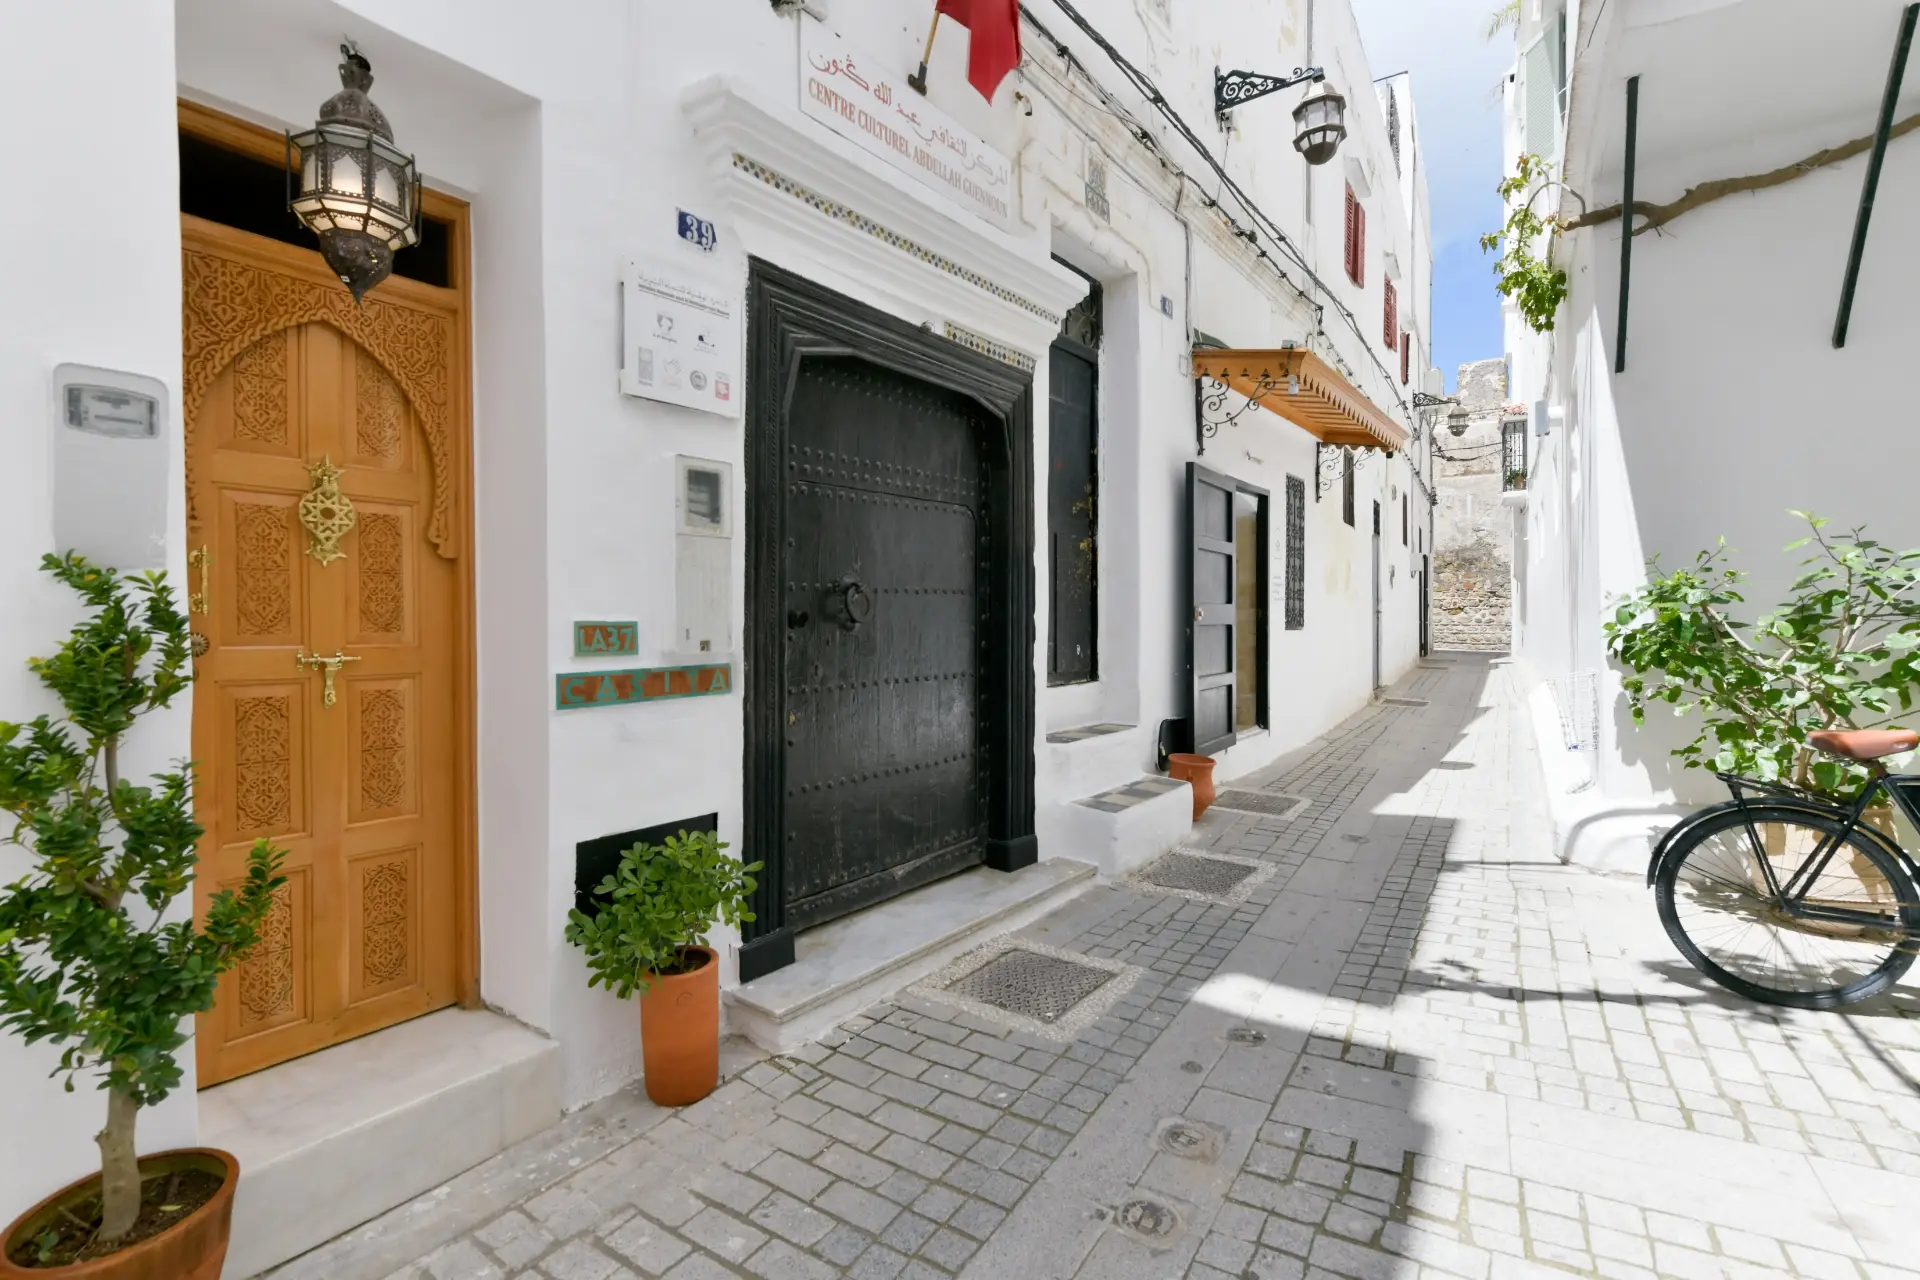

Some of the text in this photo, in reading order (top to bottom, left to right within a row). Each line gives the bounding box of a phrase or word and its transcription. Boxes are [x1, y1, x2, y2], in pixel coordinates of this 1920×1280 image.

[873, 81, 892, 107] الله
[895, 102, 921, 127] عبد
[808, 76, 856, 124] CENTRE
[858, 108, 911, 159] CULTUREL
[912, 145, 962, 191] ABDELLAH
[911, 125, 967, 158] الثقافي
[686, 215, 713, 249] 39
[564, 667, 728, 702] CASITA
